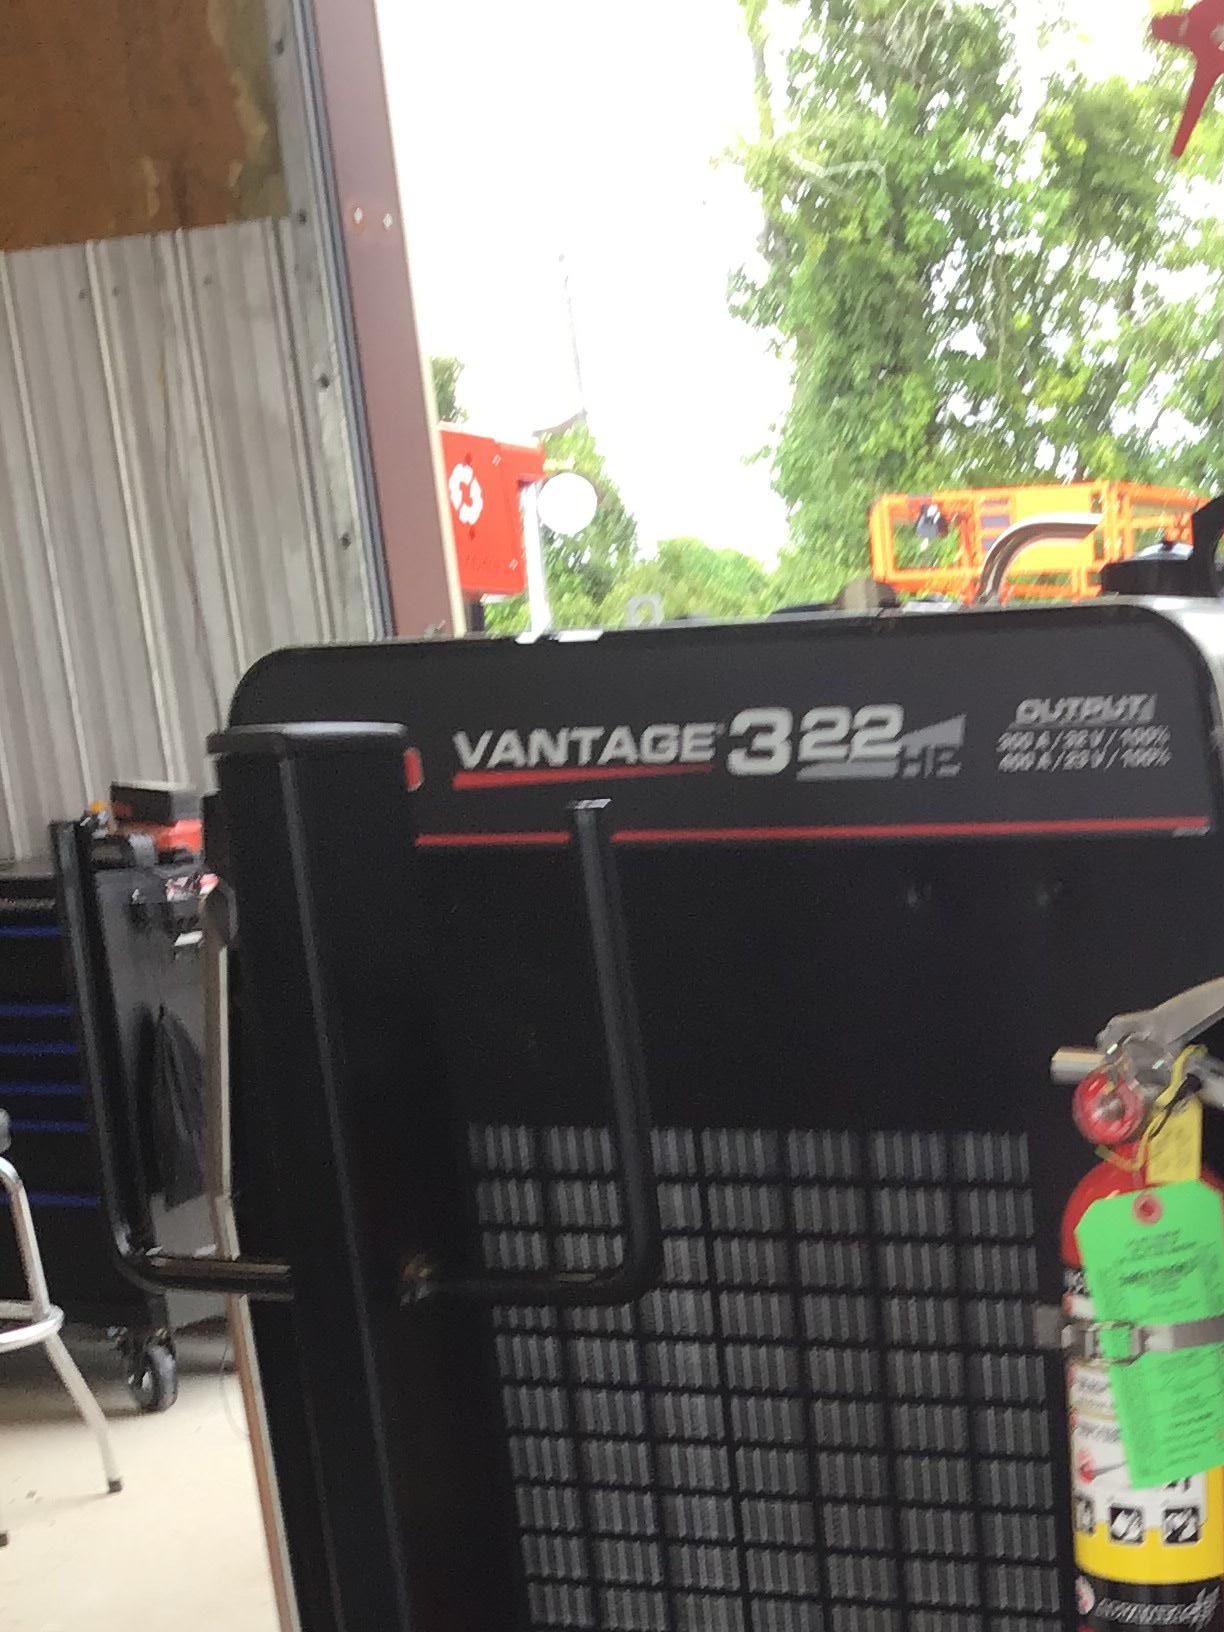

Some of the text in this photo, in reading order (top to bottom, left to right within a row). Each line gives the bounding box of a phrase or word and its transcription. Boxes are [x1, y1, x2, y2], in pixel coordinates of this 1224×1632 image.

[1013, 693, 1151, 724] OUTPUT
[453, 702, 905, 777] VANTAGE 322
